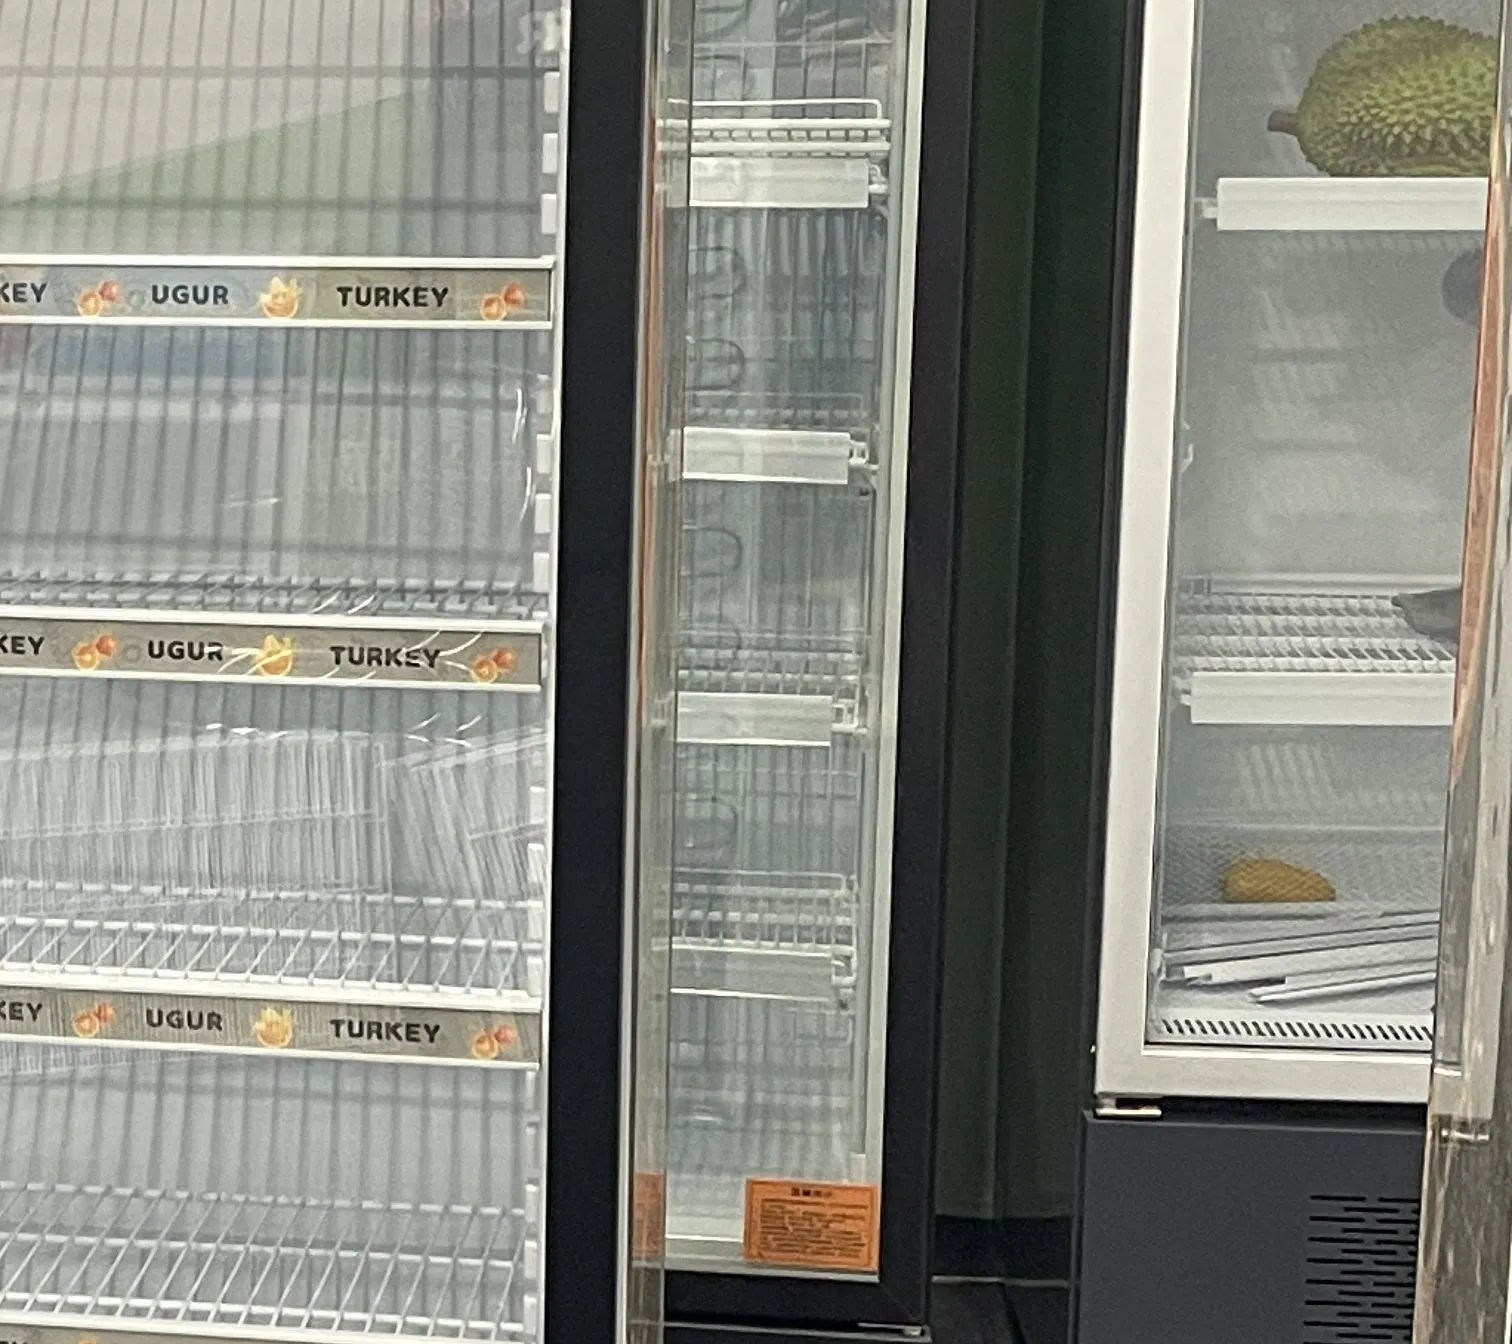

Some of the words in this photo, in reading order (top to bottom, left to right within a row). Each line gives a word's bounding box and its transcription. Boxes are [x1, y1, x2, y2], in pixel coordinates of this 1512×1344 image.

[151, 284, 229, 305] UGUR
[336, 285, 449, 308] TURKEY
[148, 640, 223, 662] UGUR
[329, 645, 442, 669] TURKEY
[146, 1008, 223, 1032] UGUR
[329, 1019, 441, 1044] TURKEY
